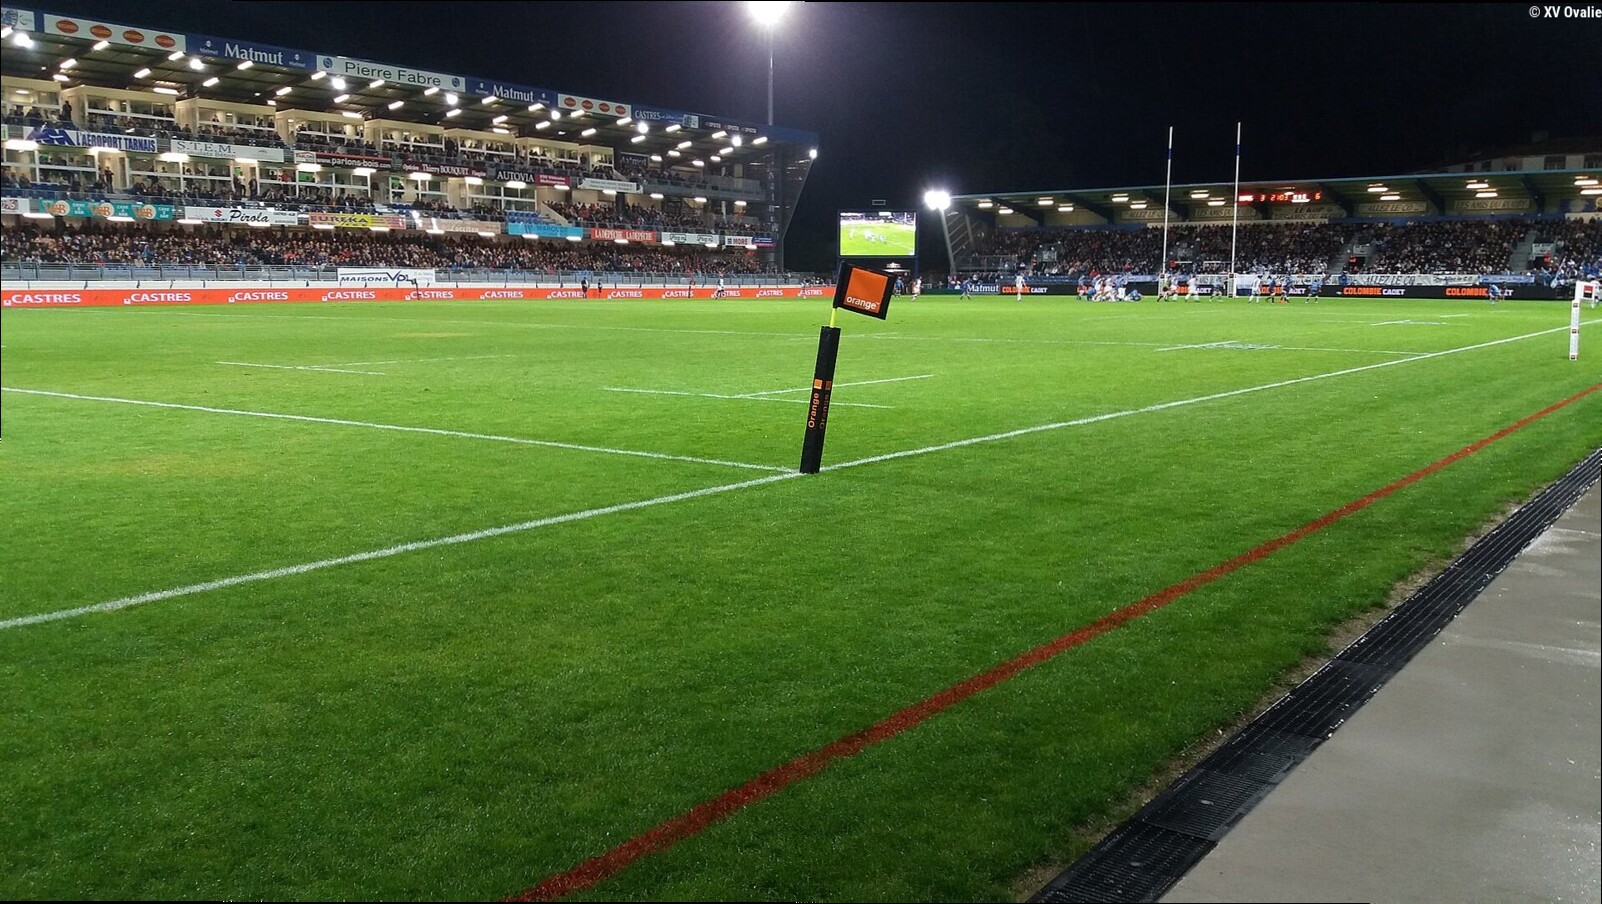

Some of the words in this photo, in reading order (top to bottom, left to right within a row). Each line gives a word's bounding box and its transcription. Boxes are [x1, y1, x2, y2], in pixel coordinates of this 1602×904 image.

[225, 42, 283, 65] Matmut
[345, 61, 392, 79] Pierre
[398, 69, 441, 86] Fabre
[493, 84, 534, 102] Matmut
[635, 110, 661, 120] CASTRES
[124, 137, 156, 152] TARNAIS
[422, 164, 440, 174] Thierry
[497, 171, 534, 182] AUTOVIA
[229, 209, 269, 223] Pirola
[310, 215, 368, 224] EUREKA
[967, 283, 999, 292] Matmut
[1343, 287, 1382, 295] COLOMBIE
[1446, 288, 1488, 296] COLOMBIE
[11, 294, 81, 304] CASTRES
[131, 293, 191, 302] CASTRES
[235, 292, 288, 300] CASTRES
[327, 291, 376, 299] CASTRES
[847, 296, 877, 310] orange
[808, 392, 820, 428] Orange
